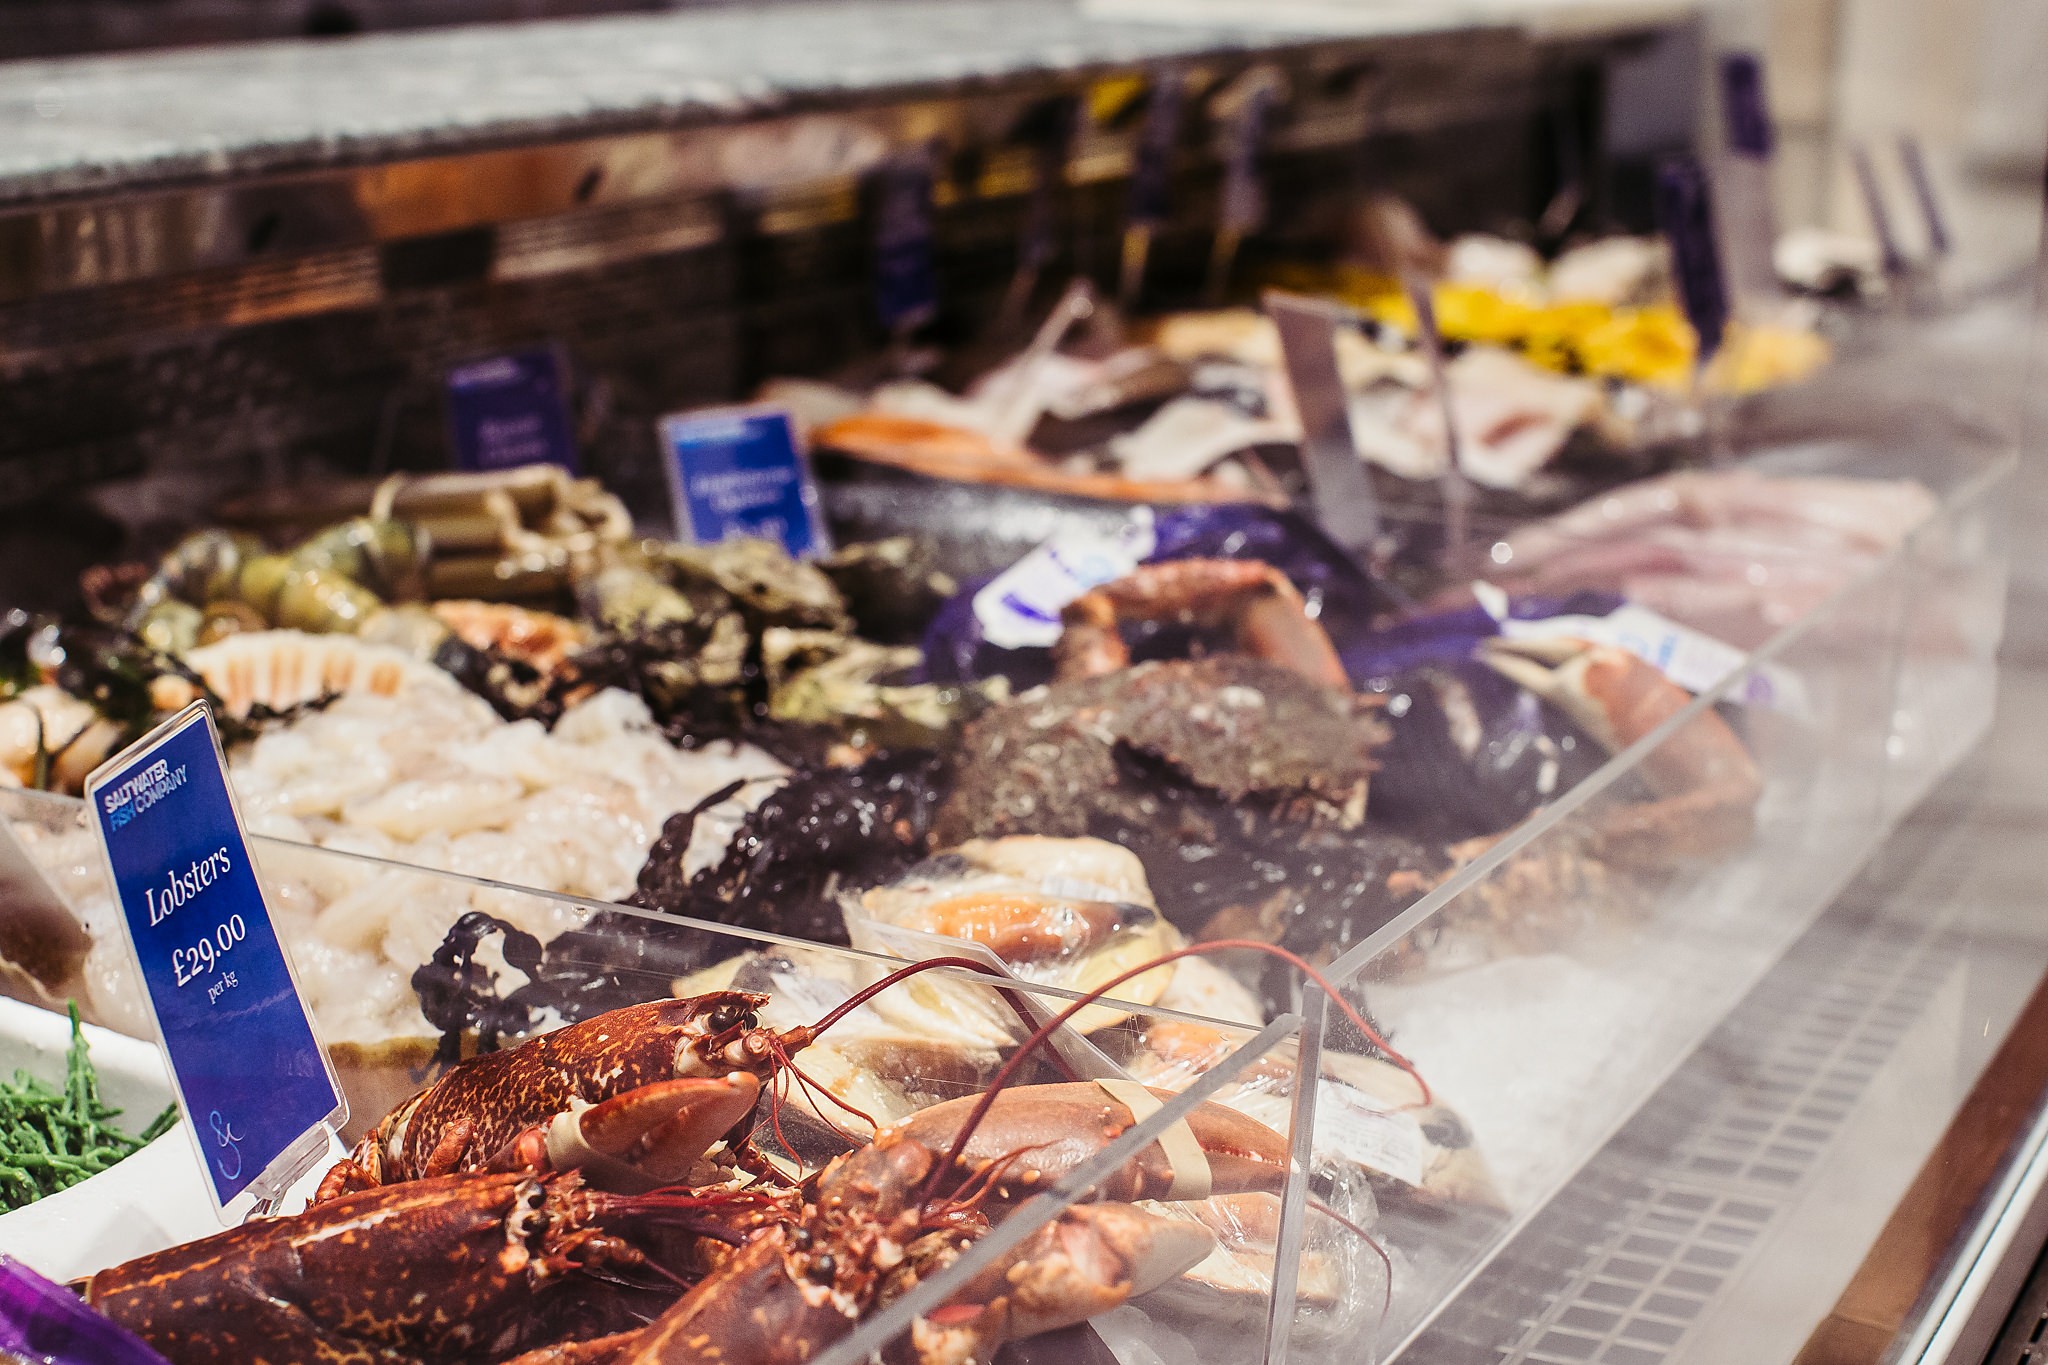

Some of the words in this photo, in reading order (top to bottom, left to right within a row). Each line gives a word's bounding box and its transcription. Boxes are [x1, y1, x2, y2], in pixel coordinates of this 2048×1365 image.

[104, 758, 169, 814] SALTWATER
[110, 801, 136, 832] FISH
[135, 764, 187, 813] COMPANY
[145, 846, 231, 927] Lobsters
[172, 913, 246, 987] £29.00
[207, 981, 224, 1005] per
[222, 970, 239, 989] kg
